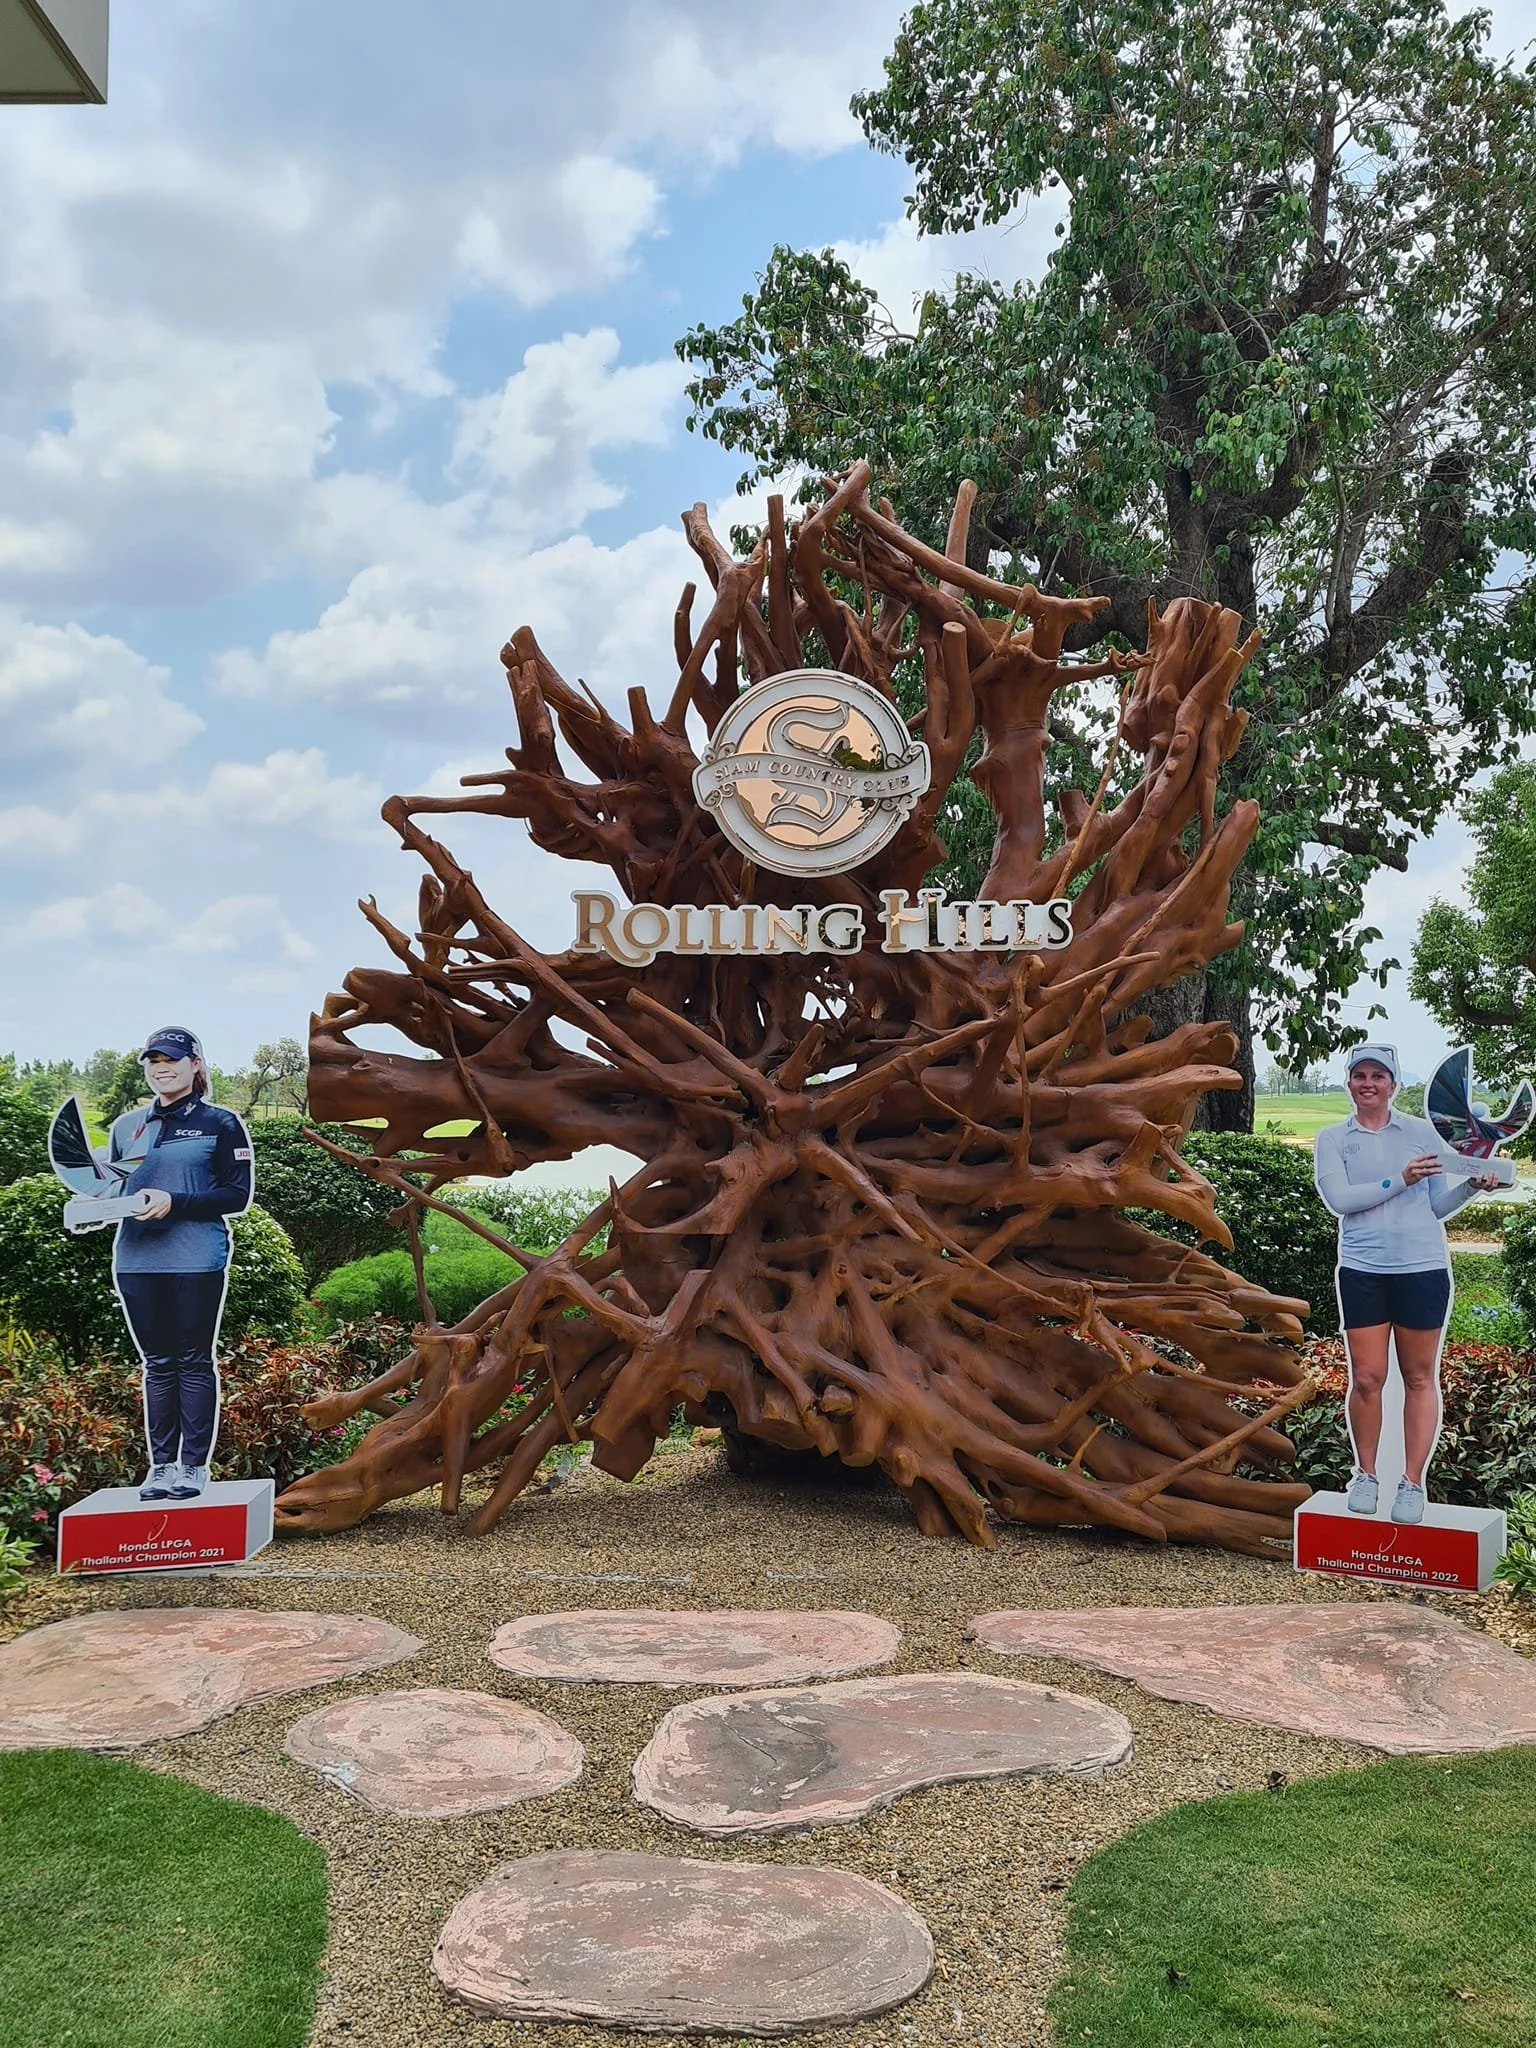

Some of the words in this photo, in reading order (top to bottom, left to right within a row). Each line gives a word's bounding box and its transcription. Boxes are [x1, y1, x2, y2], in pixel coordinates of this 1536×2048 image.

[714, 760, 760, 781] SIAM
[768, 761, 857, 789] COUNTRY
[863, 775, 910, 793] CLUB
[574, 893, 861, 962] ROLLING
[883, 892, 1072, 949] HILLS
[159, 1032, 185, 1043] SCG
[174, 1129, 203, 1137] SCGP
[119, 1541, 158, 1552] Honda
[161, 1539, 192, 1549] LPGA
[82, 1554, 132, 1566] Thailand
[135, 1551, 197, 1564] Champion
[199, 1548, 225, 1557] 2021
[1351, 1550, 1389, 1562] Honda
[1392, 1555, 1423, 1567] LPGA
[1317, 1557, 1365, 1571] Thailand
[1367, 1563, 1428, 1579] Champion
[1431, 1570, 1460, 1583] 2022
